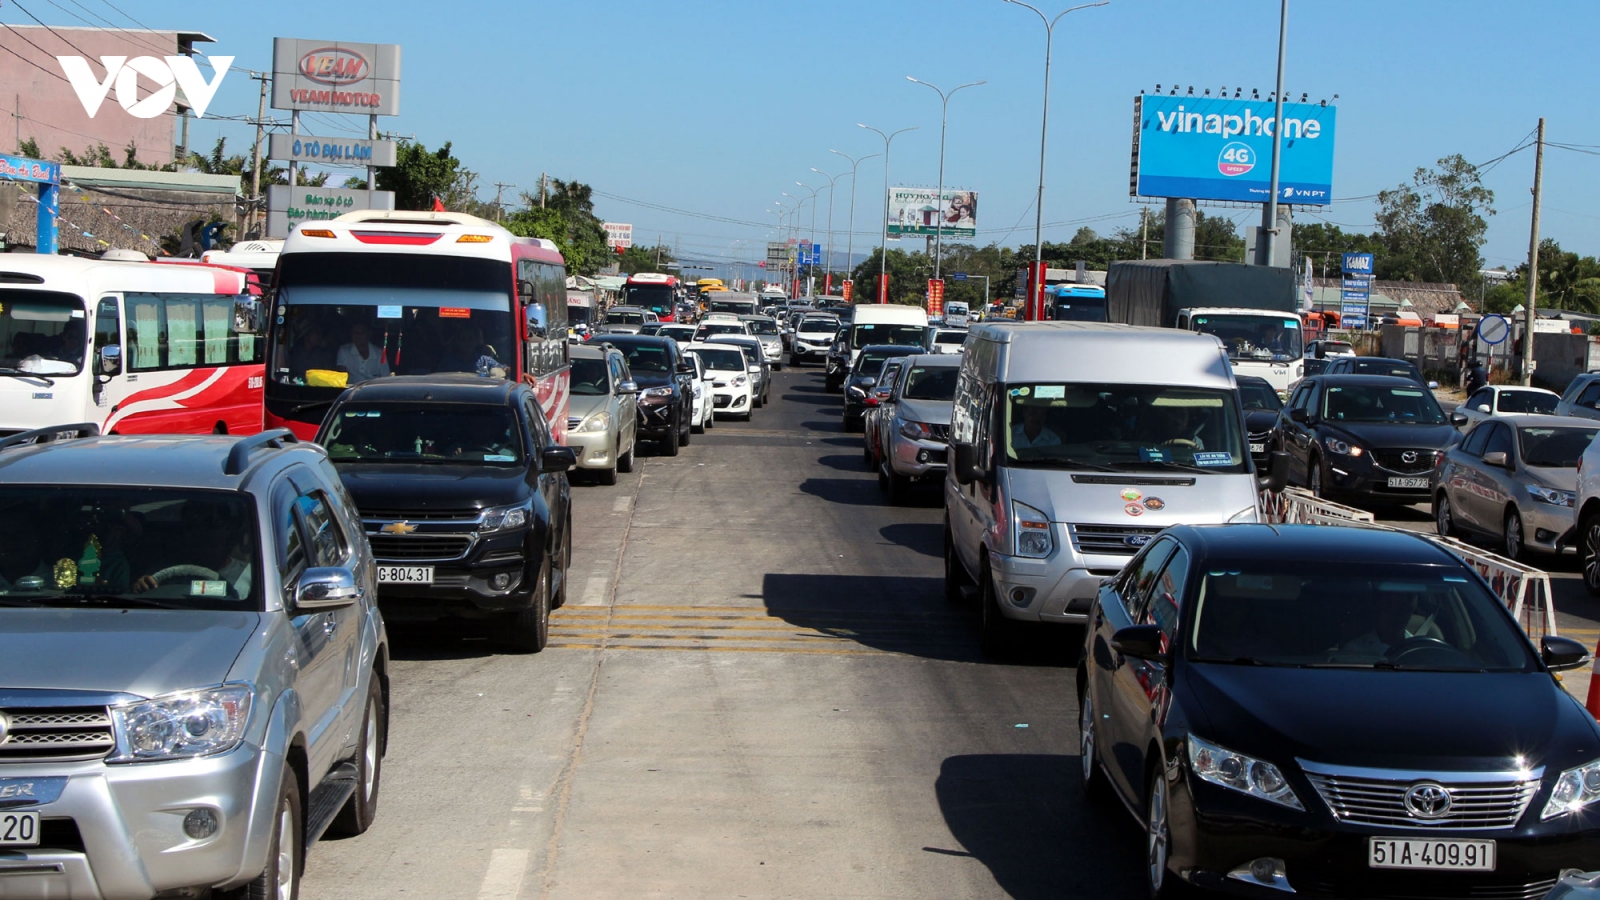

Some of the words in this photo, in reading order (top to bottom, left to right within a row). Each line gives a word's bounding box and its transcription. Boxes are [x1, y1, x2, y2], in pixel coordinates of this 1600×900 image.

[306, 56, 365, 78] VEAM
[290, 89, 331, 105] VEAM
[331, 92, 381, 107] MOTOR
[1157, 105, 1321, 139] vinaphone
[1223, 148, 1249, 163] 4G
[1346, 256, 1370, 270] KAMAZ
[1373, 841, 1487, 867] 51A-409.91
